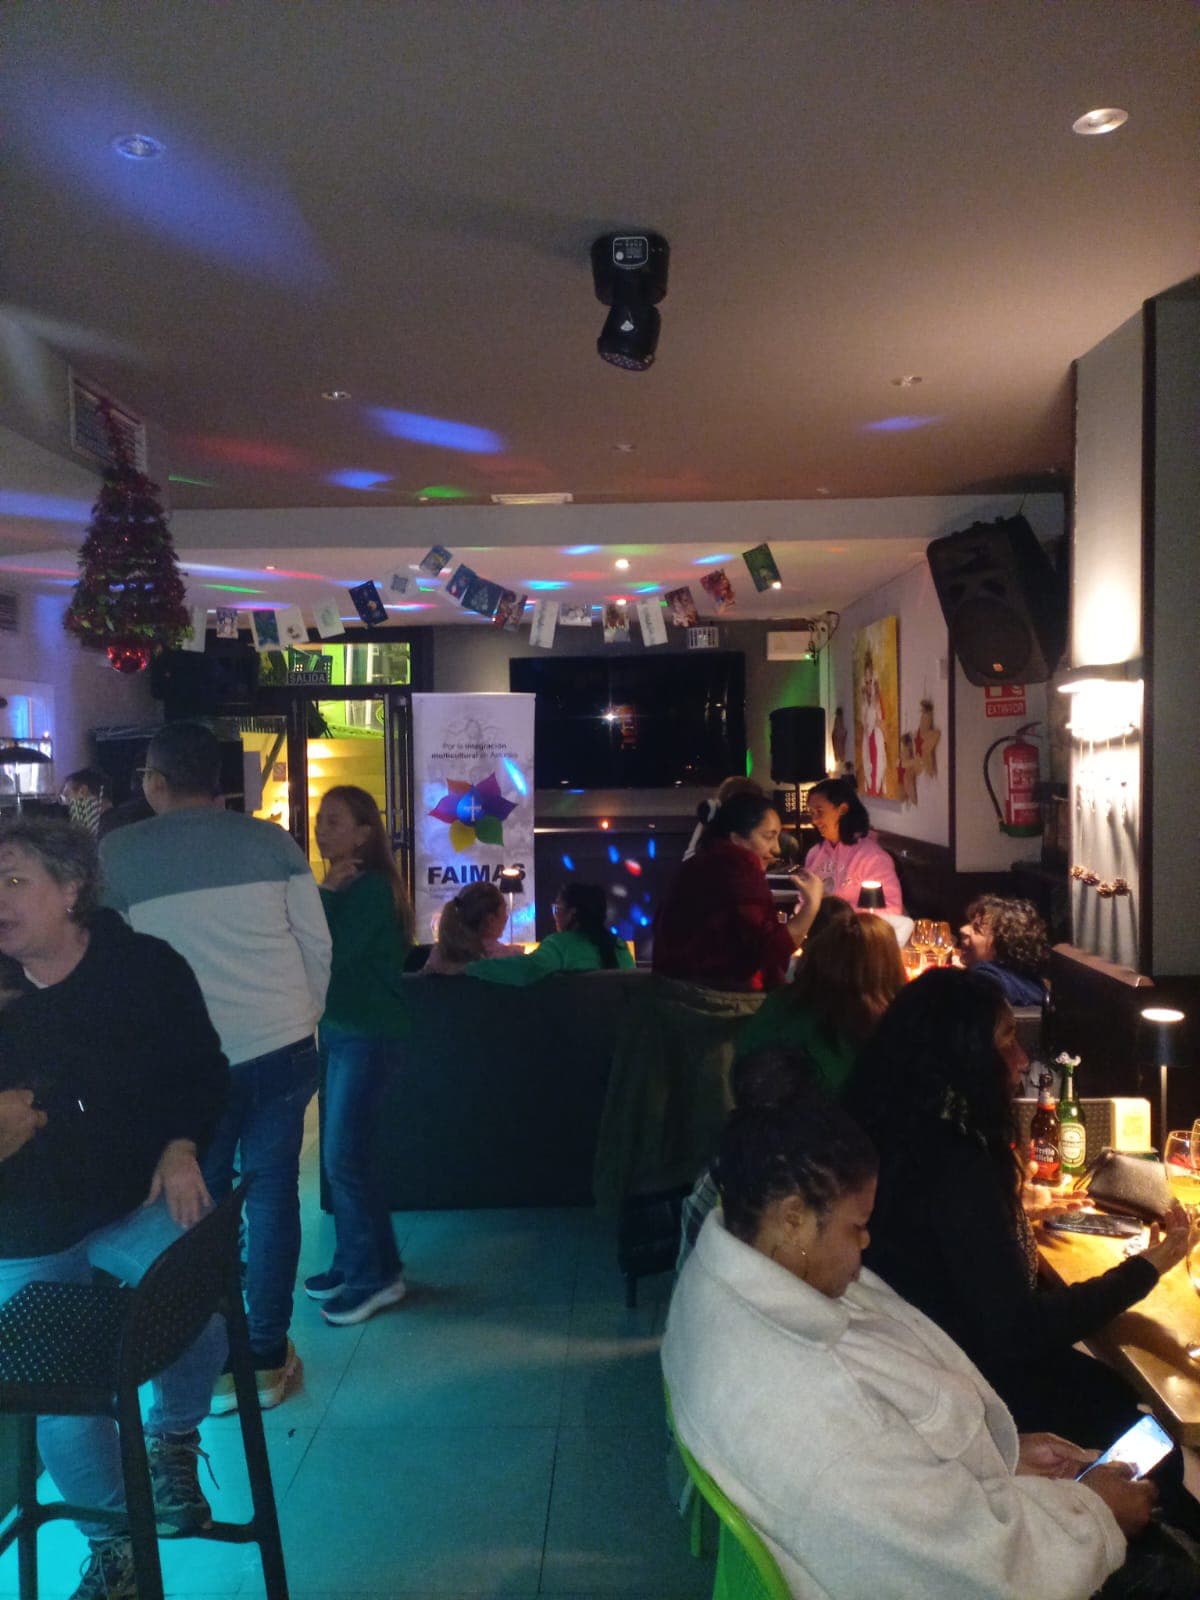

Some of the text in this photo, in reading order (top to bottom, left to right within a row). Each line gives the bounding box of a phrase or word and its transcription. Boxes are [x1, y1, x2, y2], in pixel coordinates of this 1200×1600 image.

[289, 673, 326, 684] SALIDA
[987, 702, 1025, 716] EXTINTOR
[431, 752, 479, 760] multicultural
[428, 863, 526, 885] FAIMAS
